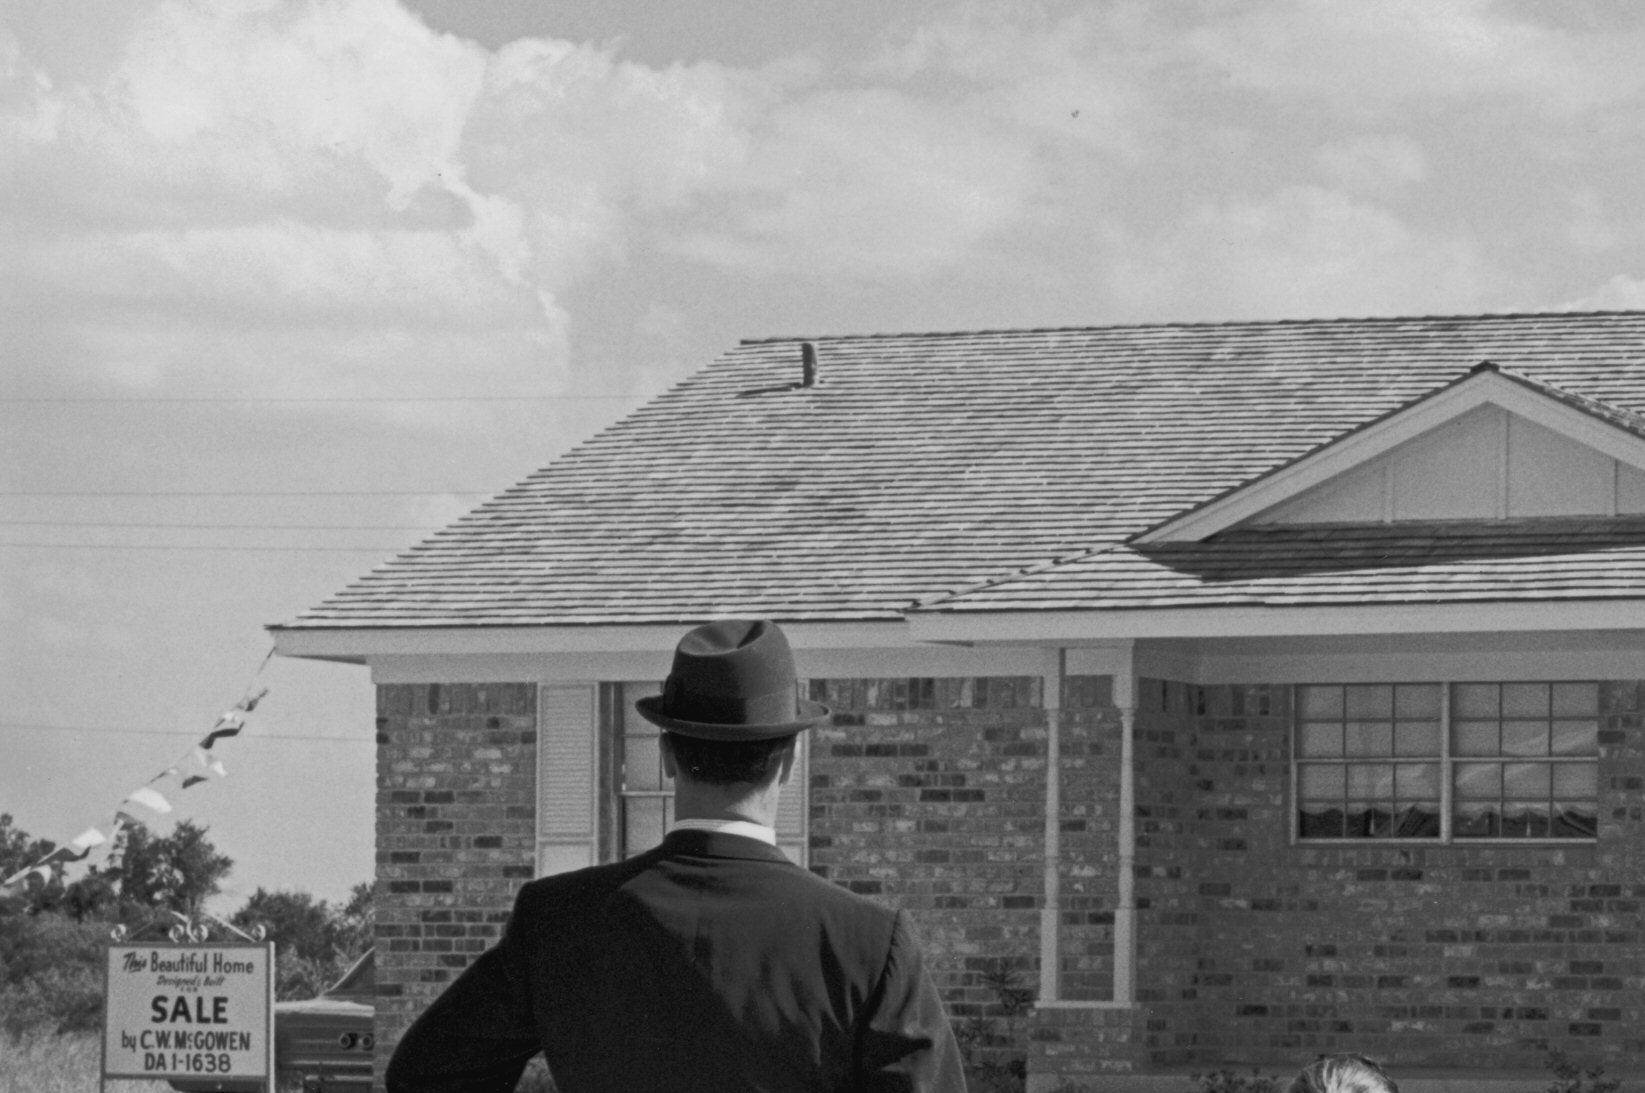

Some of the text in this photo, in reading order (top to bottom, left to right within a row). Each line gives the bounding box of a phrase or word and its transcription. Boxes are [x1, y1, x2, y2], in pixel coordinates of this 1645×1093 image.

[123, 951, 254, 975] This Beautiful Home
[150, 995, 229, 1024] SALE
[121, 1030, 137, 1053] by
[144, 1053, 232, 1073] DA 1-1638
